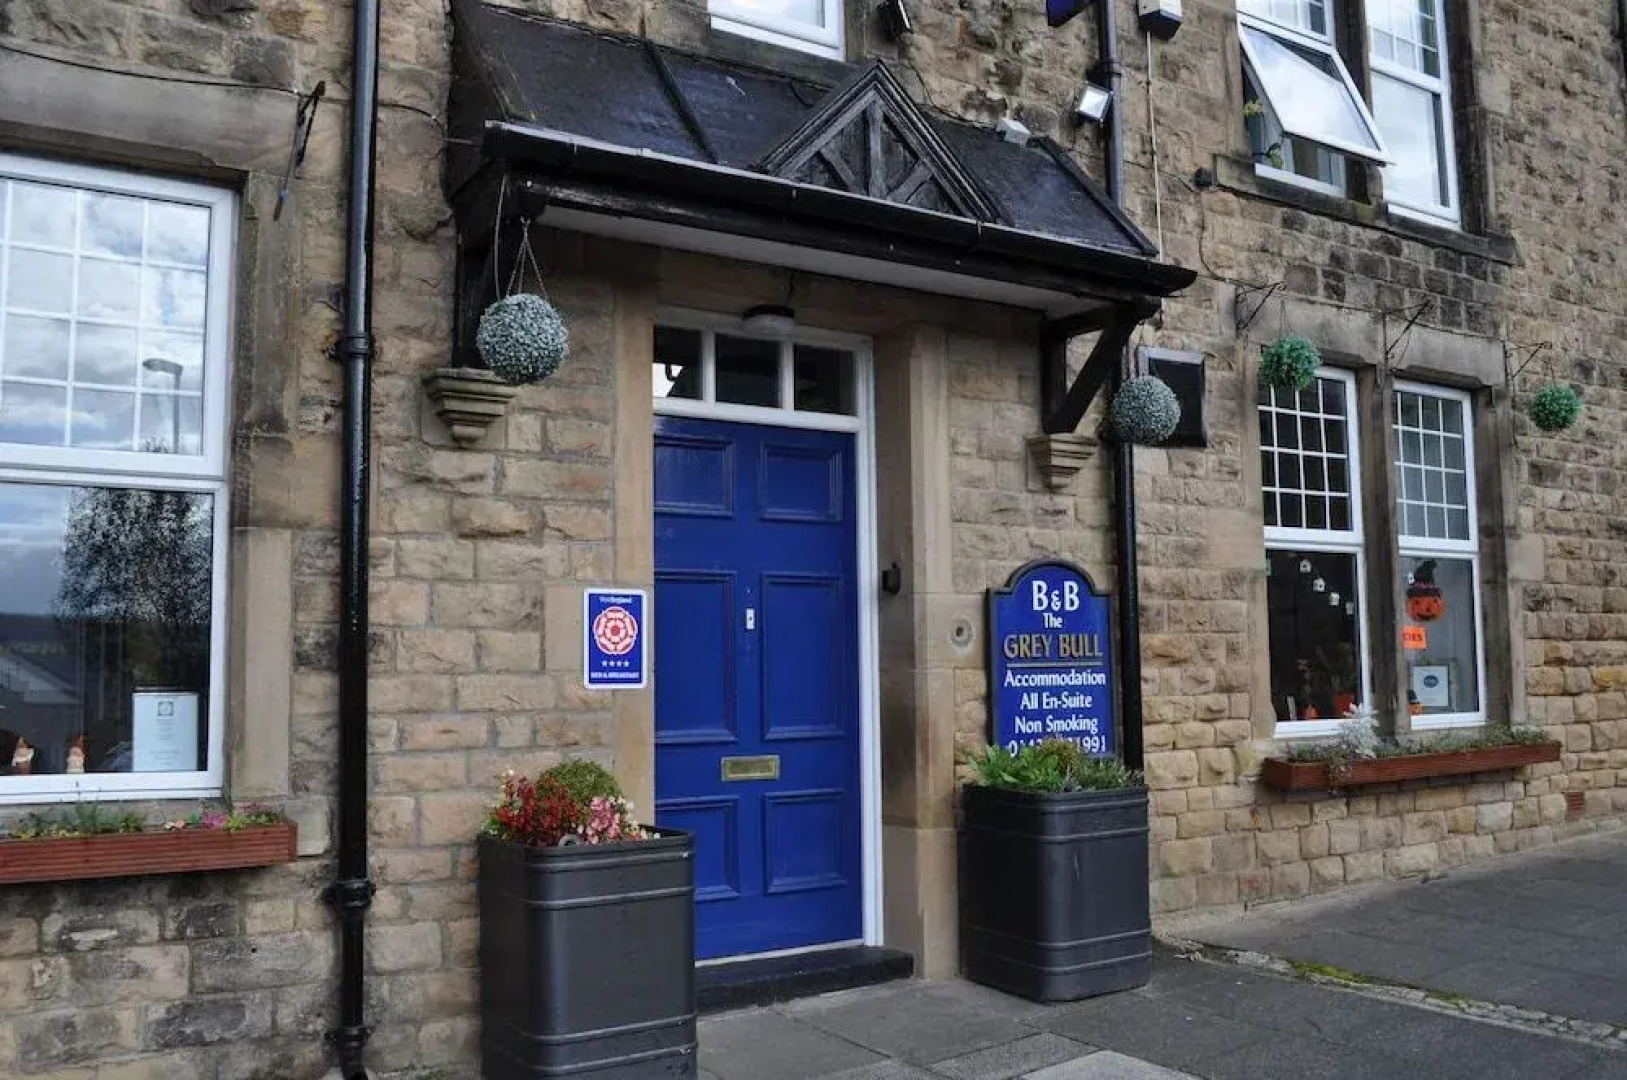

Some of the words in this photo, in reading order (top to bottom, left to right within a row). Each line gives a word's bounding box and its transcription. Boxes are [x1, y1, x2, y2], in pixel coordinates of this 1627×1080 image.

[1043, 612, 1063, 629] The
[1003, 633, 1052, 658] GREY
[1059, 633, 1103, 658] BULL
[1004, 669, 1106, 687] Accommodation
[1020, 692, 1039, 710] All
[1042, 691, 1093, 710] En-Suite
[1014, 716, 1043, 734] Non
[1045, 714, 1099, 735] Smoking
